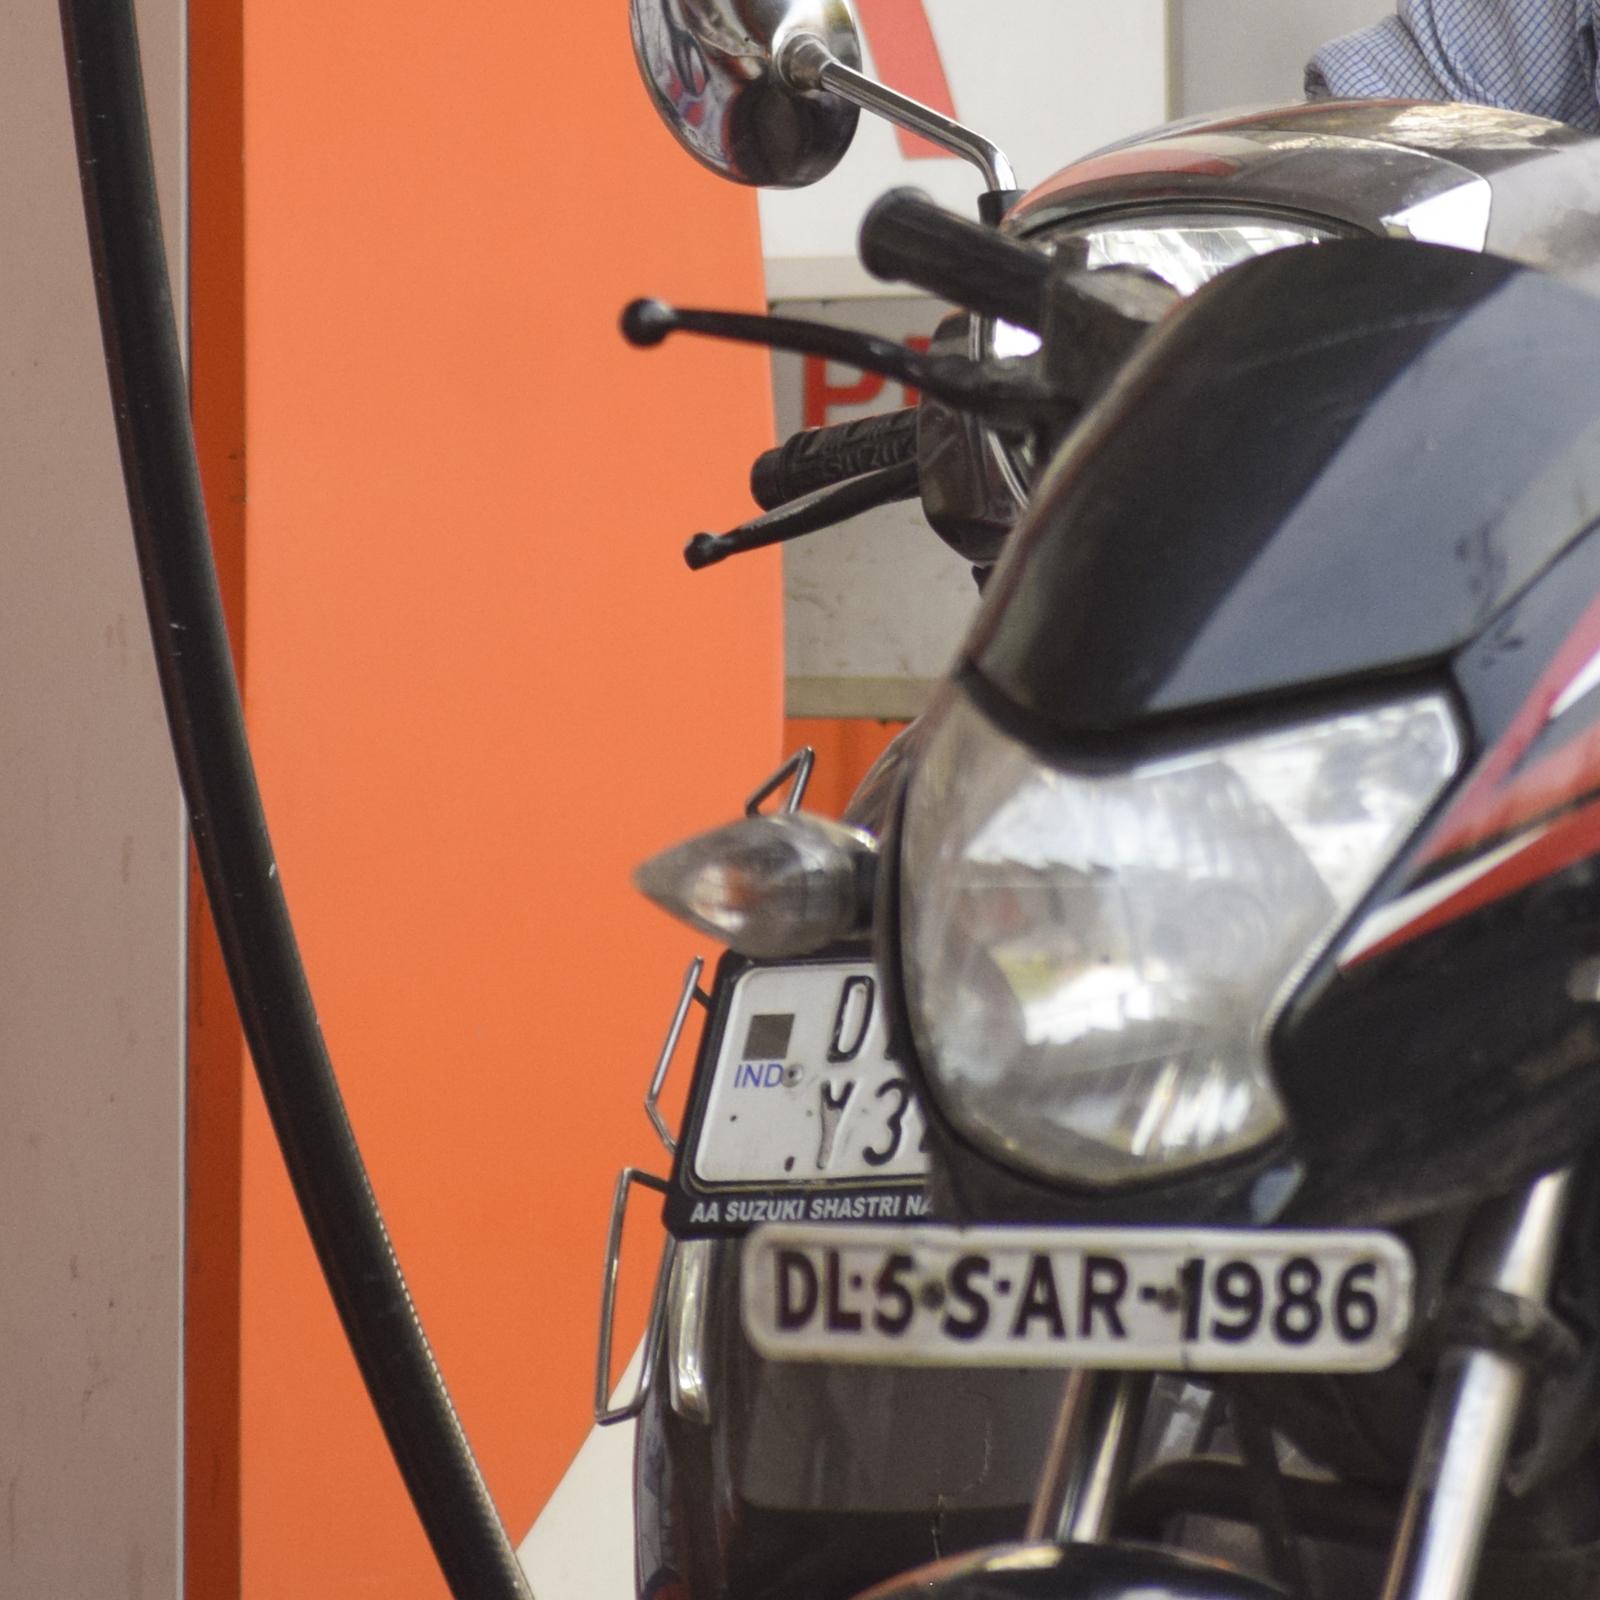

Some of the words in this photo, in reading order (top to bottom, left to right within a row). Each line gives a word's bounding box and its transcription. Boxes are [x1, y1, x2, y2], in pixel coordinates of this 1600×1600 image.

[732, 1062, 784, 1090] IND
[689, 1201, 721, 1225] AA
[724, 1198, 806, 1224] SUZUKI
[810, 1195, 902, 1221] SHASTRI
